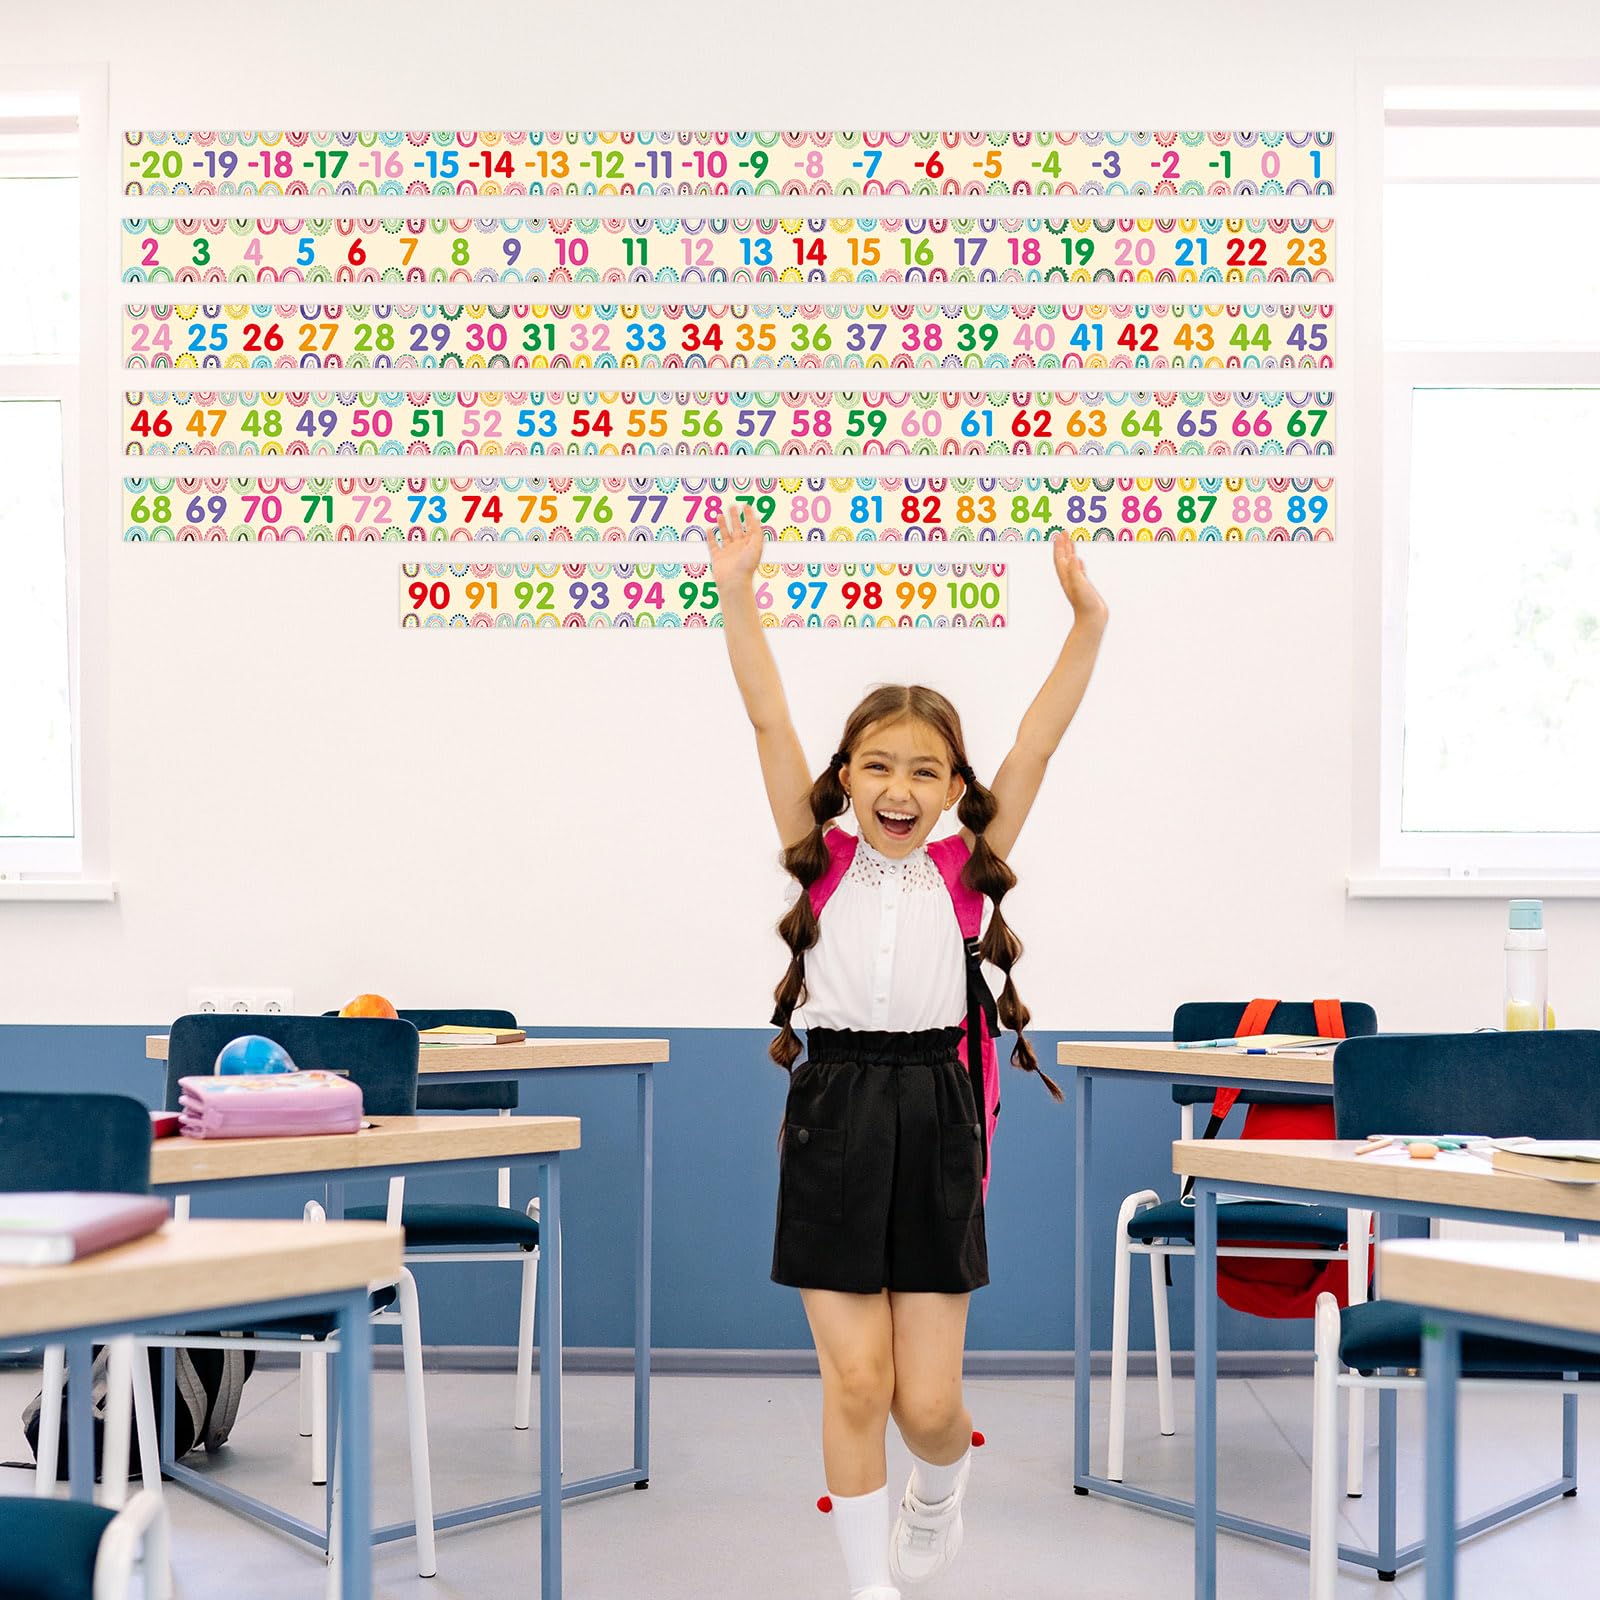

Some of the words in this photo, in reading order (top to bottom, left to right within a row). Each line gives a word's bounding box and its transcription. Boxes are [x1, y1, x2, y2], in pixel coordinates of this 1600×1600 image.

[130, 150, 183, 178] -20
[193, 151, 238, 178] -19
[248, 151, 293, 178] -18
[303, 150, 349, 179] -17
[359, 151, 403, 178] -16
[414, 150, 459, 179] -15
[469, 151, 515, 178] -14
[525, 150, 570, 178] -13
[580, 151, 624, 178] -12
[635, 151, 672, 178] -11
[682, 151, 727, 178] -10
[738, 150, 769, 179] -9
[795, 151, 823, 178] -8
[852, 150, 882, 179] -7
[914, 151, 944, 179] -6
[973, 150, 1002, 179] -5
[1031, 150, 1062, 179] -4
[1092, 151, 1121, 178] -3
[1151, 151, 1180, 179] -2
[1209, 150, 1231, 179] -1
[1261, 151, 1280, 178] 0
[1309, 150, 1320, 179] 1
[141, 238, 159, 266] 2
[192, 238, 210, 266] 3
[244, 238, 263, 266] 4
[296, 238, 315, 266] 5
[348, 238, 366, 266] 6
[399, 238, 418, 266] 7
[451, 238, 470, 266] 8
[503, 238, 521, 266] 9
[554, 238, 589, 266] 10
[622, 238, 647, 266] 11
[681, 238, 714, 266] 12
[739, 238, 774, 266] 13
[792, 238, 827, 266] 14
[847, 238, 880, 266] 15
[900, 238, 934, 266] 16
[954, 238, 988, 266] 17
[1007, 238, 1041, 266] 18
[1061, 238, 1095, 266] 19
[1115, 238, 1155, 265] 20
[1175, 238, 1207, 266] 21
[1226, 238, 1267, 266] 22
[1287, 238, 1327, 266] 23
[132, 324, 172, 351] 24
[188, 323, 228, 352] 25
[243, 323, 284, 351] 26
[298, 323, 339, 352] 27
[354, 323, 395, 351] 28
[410, 323, 450, 351] 29
[466, 323, 507, 351] 30
[522, 323, 555, 351] 31
[570, 324, 610, 351] 32
[625, 323, 666, 352] 33
[681, 323, 723, 351] 34
[736, 323, 776, 352] 35
[791, 323, 832, 351] 36
[846, 323, 887, 351] 37
[902, 323, 942, 351] 38
[957, 323, 998, 351] 39
[1013, 324, 1055, 351] 40
[1070, 323, 1103, 352] 41
[1117, 323, 1159, 351] 42
[1173, 323, 1215, 352] 43
[1229, 323, 1272, 352] 44
[1287, 323, 1327, 351] 45
[130, 409, 172, 437] 46
[186, 409, 227, 438] 47
[241, 409, 282, 437] 48
[296, 410, 337, 437] 49
[351, 410, 393, 437] 50
[410, 409, 444, 437] 51
[462, 410, 502, 437] 52
[516, 409, 557, 437] 53
[571, 409, 613, 437] 54
[626, 409, 668, 437] 55
[681, 410, 723, 437] 56
[736, 410, 776, 437] 57
[791, 410, 832, 437] 58
[846, 410, 887, 437] 59
[902, 410, 942, 437] 60
[961, 410, 993, 437] 61
[1011, 409, 1052, 437] 62
[1066, 409, 1107, 437] 63
[1121, 409, 1163, 437] 64
[1177, 410, 1217, 437] 65
[1232, 410, 1272, 437] 66
[1287, 409, 1328, 437] 67
[131, 495, 172, 523] 68
[186, 496, 227, 523] 69
[241, 495, 282, 523] 70
[300, 495, 333, 523] 71
[352, 496, 392, 523] 72
[407, 495, 447, 524] 73
[461, 495, 503, 523] 74
[517, 495, 558, 524] 75
[572, 496, 613, 523] 76
[627, 495, 668, 523] 77
[683, 495, 722, 523] 78
[791, 496, 831, 523] 80
[850, 495, 882, 524] 81
[901, 495, 941, 523] 82
[956, 495, 997, 524] 83
[1011, 495, 1052, 523] 84
[1067, 495, 1107, 523] 85
[1121, 496, 1162, 523] 86
[1177, 495, 1217, 523] 87
[1232, 496, 1272, 523] 88
[1287, 495, 1328, 524] 89
[408, 582, 450, 610] 90
[465, 582, 497, 610] 91
[514, 582, 555, 610] 92
[569, 582, 609, 609] 93
[624, 582, 665, 609] 94
[678, 582, 719, 609] 95
[787, 581, 828, 610] 97
[841, 582, 883, 610] 98
[896, 581, 937, 609] 99
[947, 582, 1000, 609] 100
